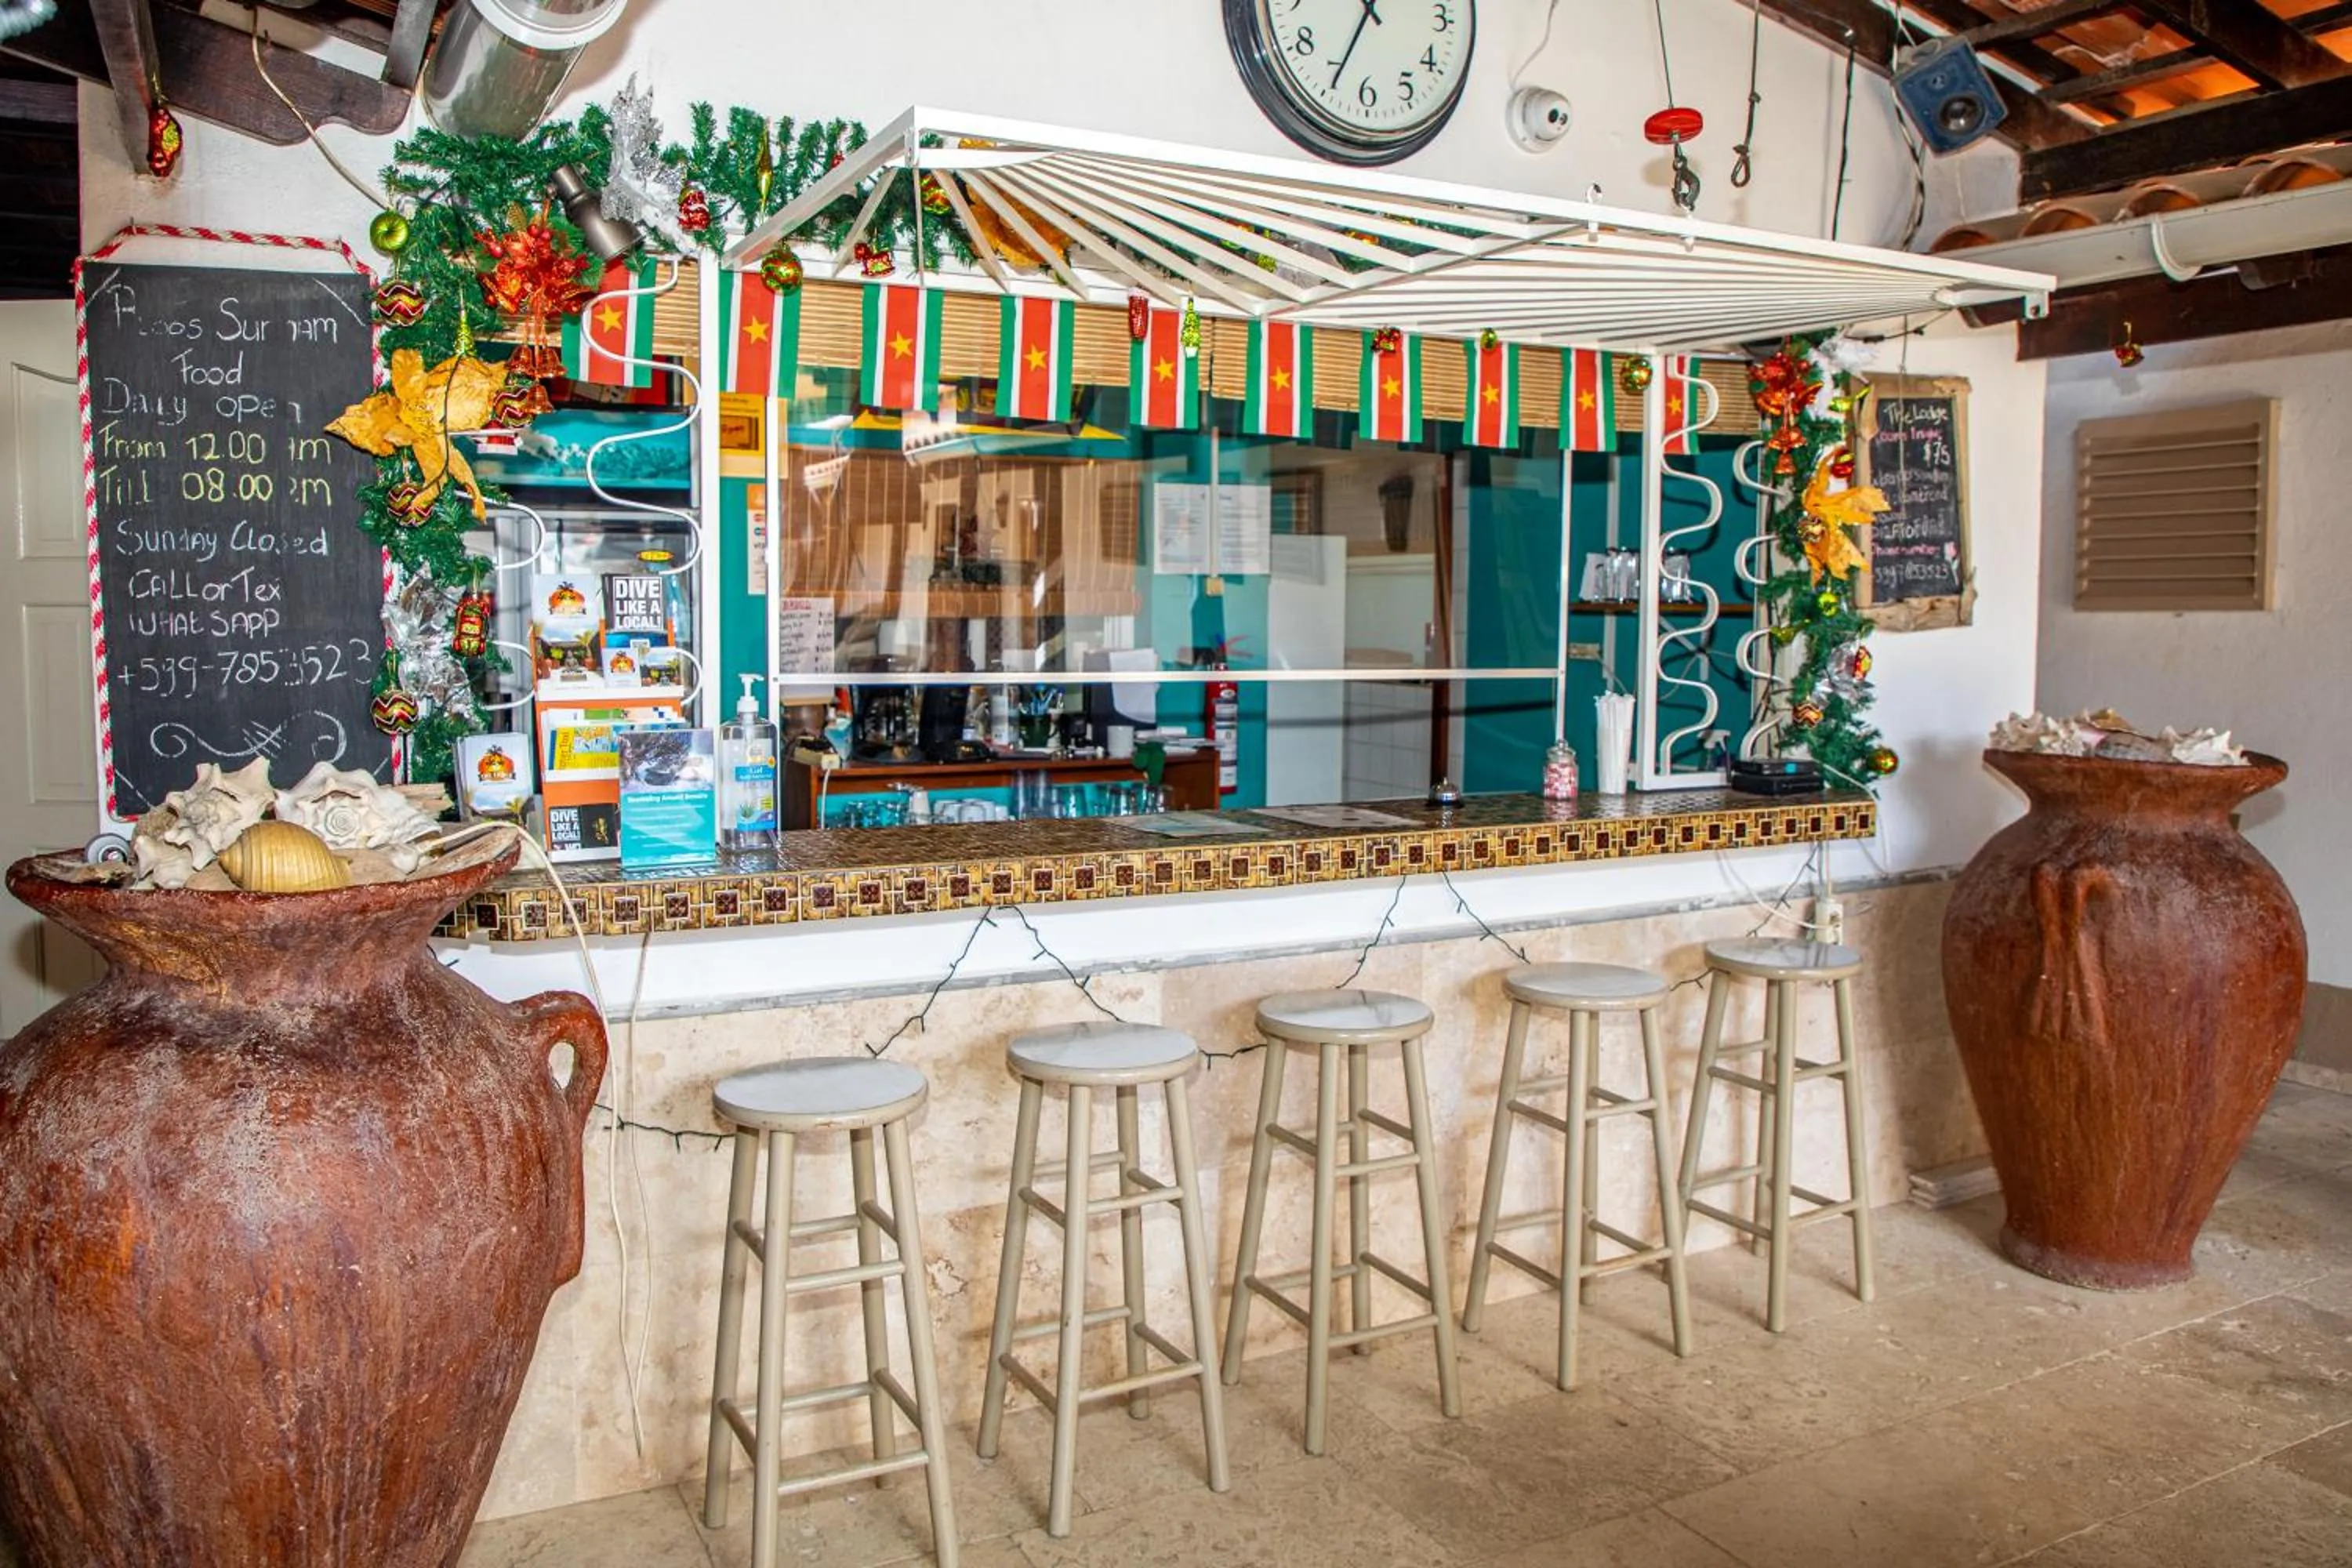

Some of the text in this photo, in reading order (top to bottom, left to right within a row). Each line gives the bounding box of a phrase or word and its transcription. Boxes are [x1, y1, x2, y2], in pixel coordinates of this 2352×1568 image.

[1432, 4, 1447, 32] 3
[1296, 26, 1314, 56] 8
[1419, 44, 1436, 72] 4
[1359, 74, 1377, 107] 6
[1398, 71, 1414, 101] 5
[171, 349, 244, 387] Food
[201, 582, 233, 601] or
[615, 579, 659, 598] DIVE
[615, 600, 660, 614] LIKE A
[551, 809, 578, 822] DIVE
